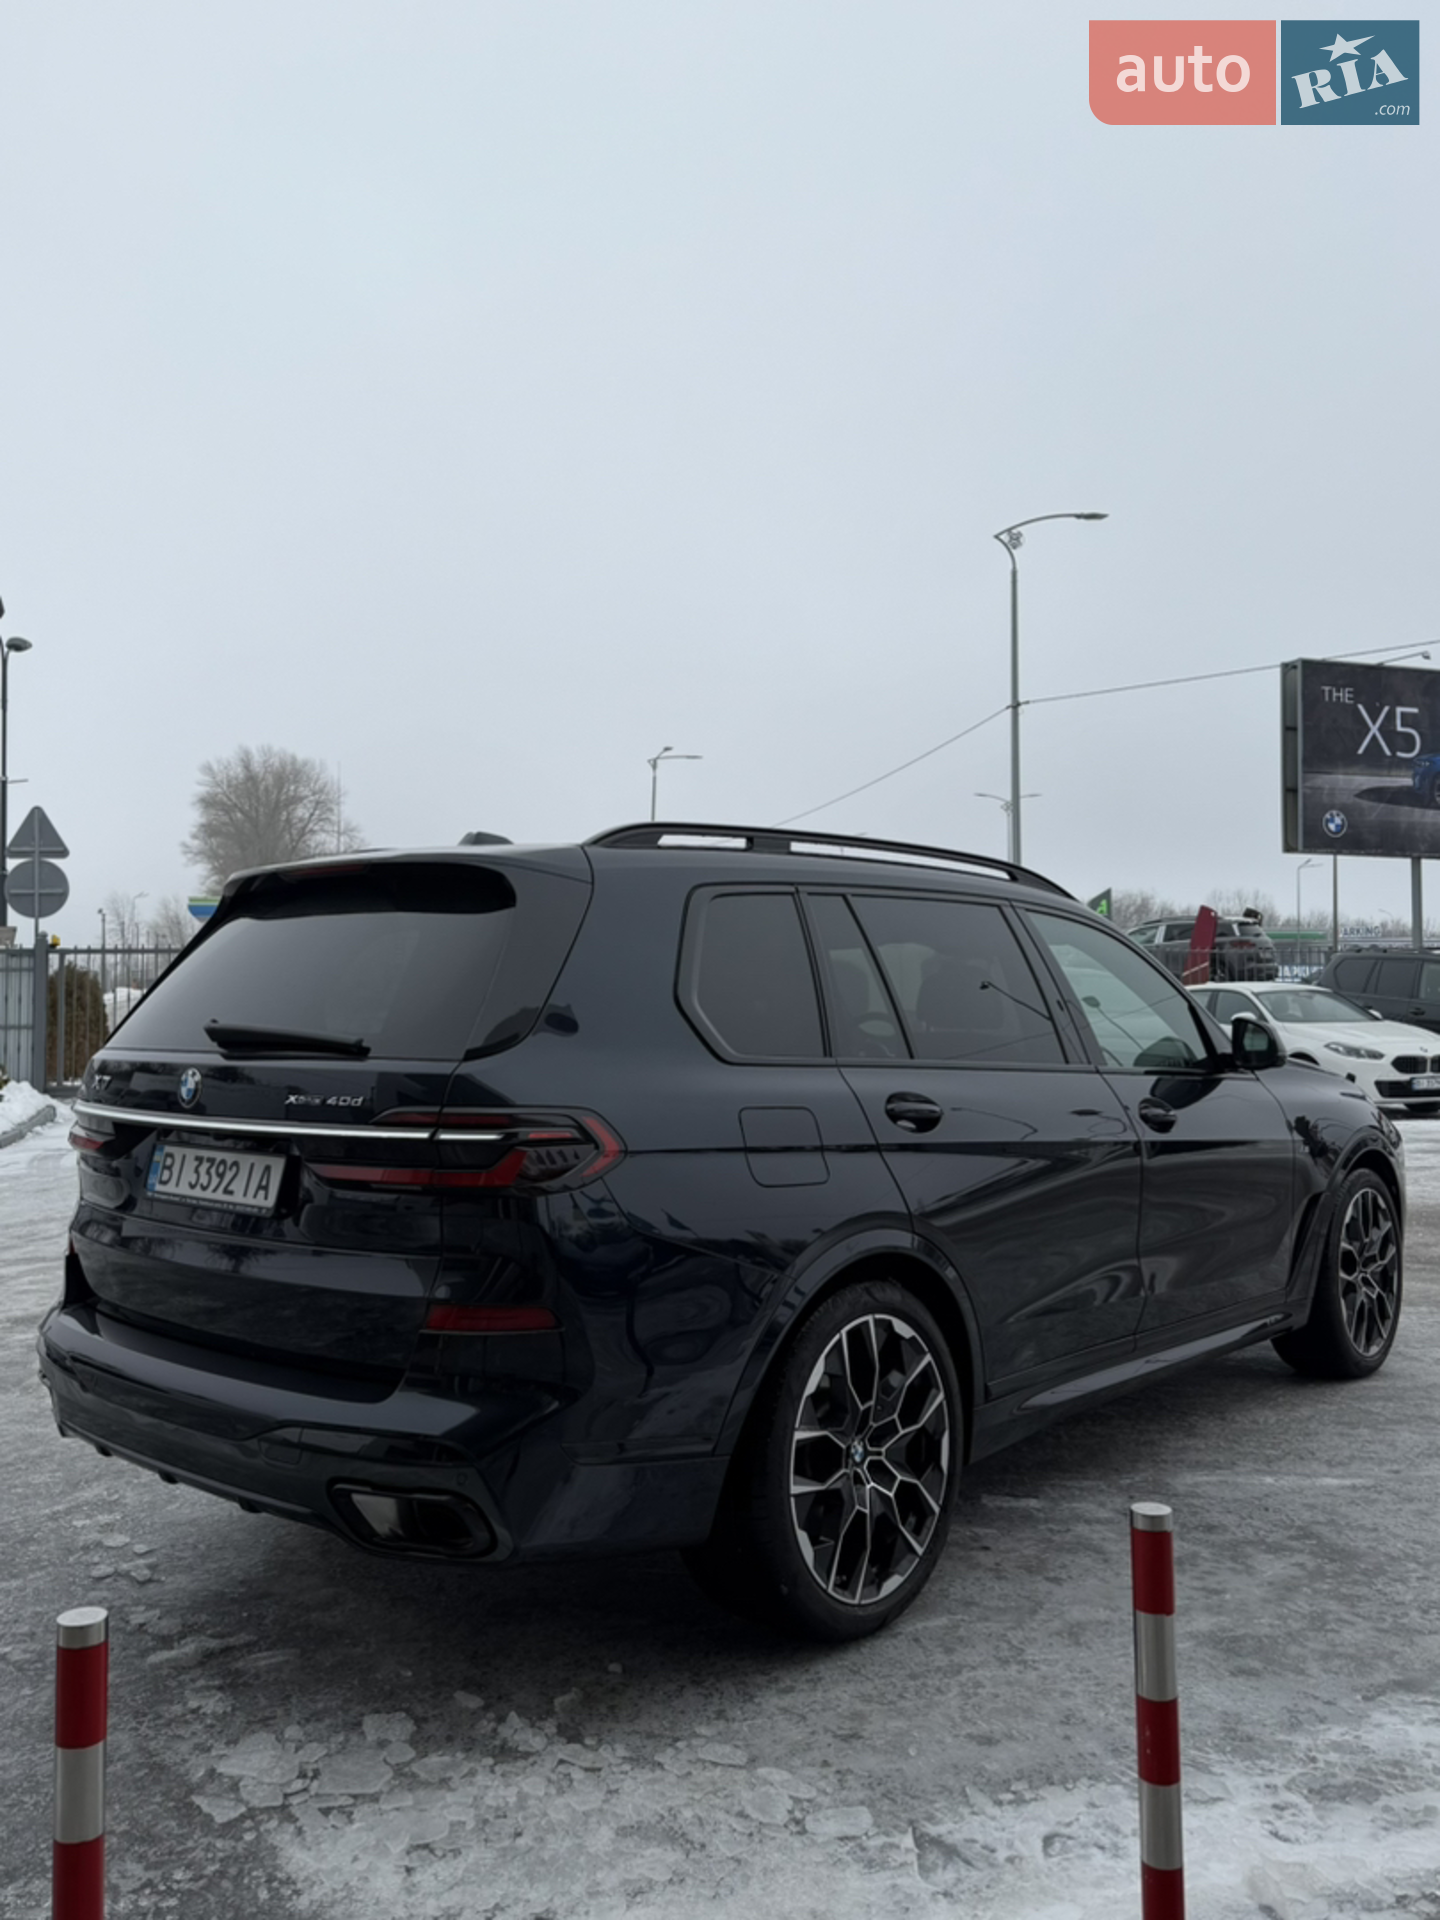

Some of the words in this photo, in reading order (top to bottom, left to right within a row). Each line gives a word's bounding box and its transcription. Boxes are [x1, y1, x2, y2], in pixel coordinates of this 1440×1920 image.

[1321, 686, 1355, 704] THE
[1356, 703, 1422, 758] X5
[1340, 926, 1381, 937] ARKING
[326, 1096, 364, 1107] 40d
[158, 1152, 186, 1188] BI
[188, 1155, 240, 1196] 3392
[243, 1162, 272, 1201] IA
